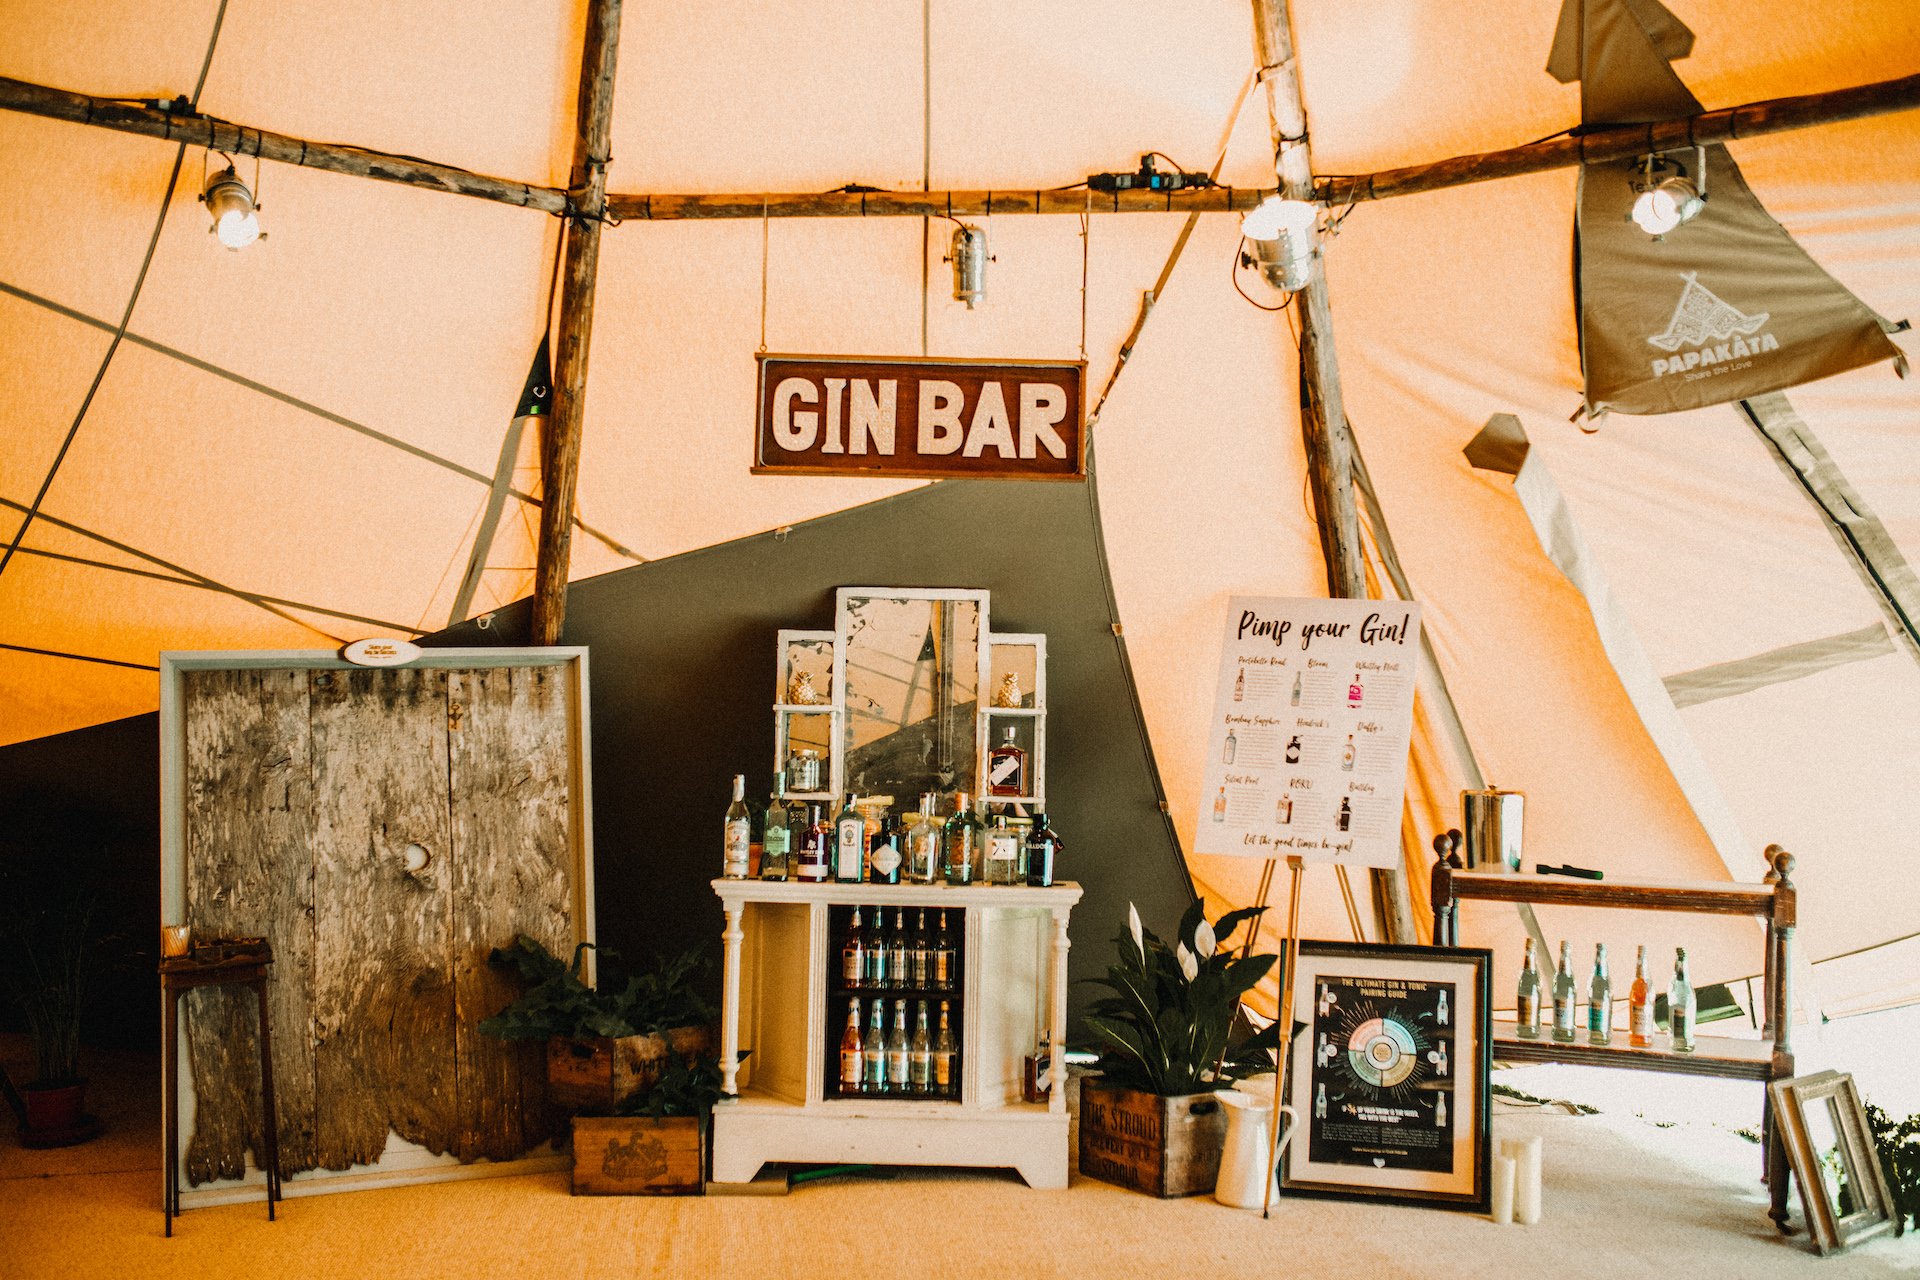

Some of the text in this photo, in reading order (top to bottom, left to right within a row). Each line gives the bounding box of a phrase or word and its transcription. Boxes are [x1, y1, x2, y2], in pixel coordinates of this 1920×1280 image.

[1684, 359, 1753, 382] Share the Love
[772, 376, 1068, 459] GIN BAR
[1237, 610, 1409, 650] Pimp your Gin!
[1270, 656, 1287, 666] Road
[1307, 657, 1329, 669] Bloom
[1225, 713, 1251, 726] Bombay
[1244, 832, 1257, 846] Let
[1259, 833, 1271, 846] the
[1273, 835, 1294, 851] good
[1296, 838, 1319, 850] times
[1342, 978, 1428, 992] THE ULTIMATE GIN & TONIC
[1360, 988, 1408, 999] PAIRING GUIDE
[1087, 1102, 1156, 1141] THE STROUD
